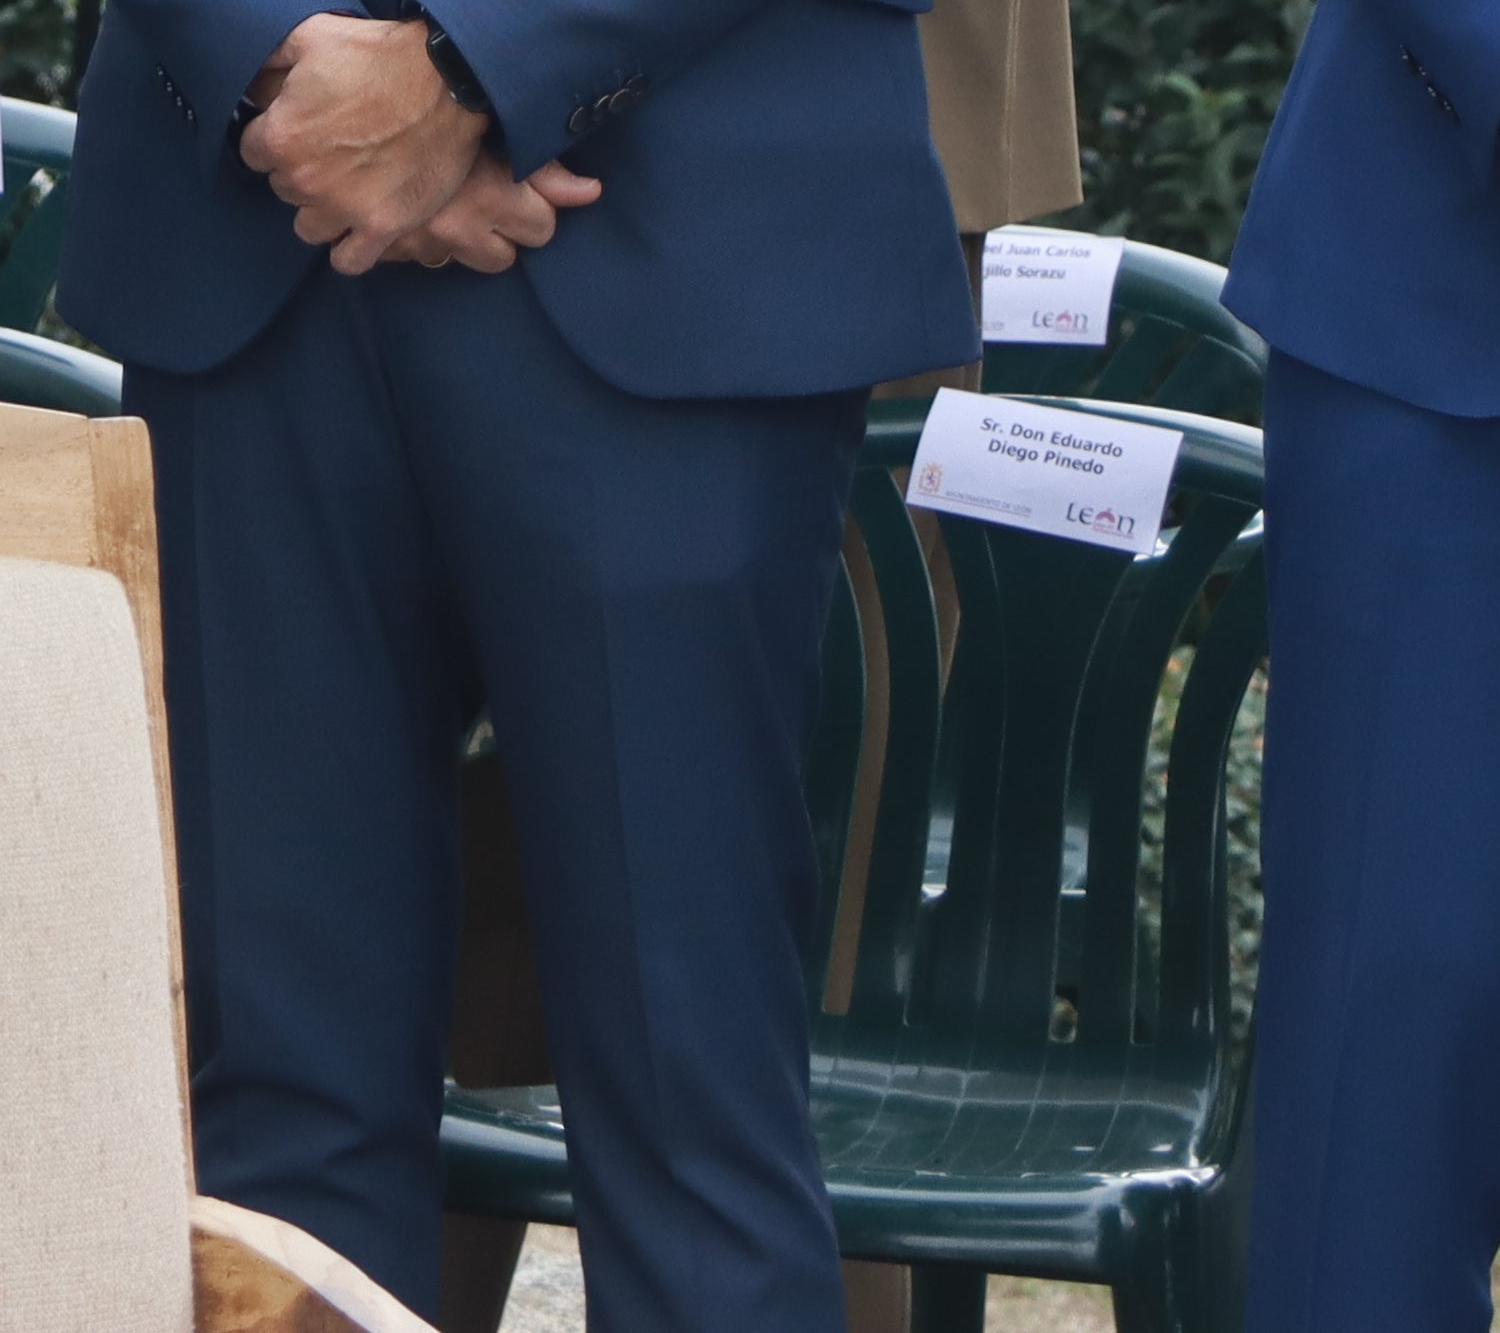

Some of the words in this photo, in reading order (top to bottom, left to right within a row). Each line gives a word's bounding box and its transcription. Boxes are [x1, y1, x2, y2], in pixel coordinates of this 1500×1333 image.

[1006, 244, 1041, 256] Juan
[1045, 245, 1091, 258] Carlos
[980, 417, 1005, 434] Sr.
[1010, 424, 1045, 441] Don
[1050, 432, 1124, 459] Eduardo
[987, 440, 1039, 463] Diego
[1043, 450, 1105, 476] Pinedo
